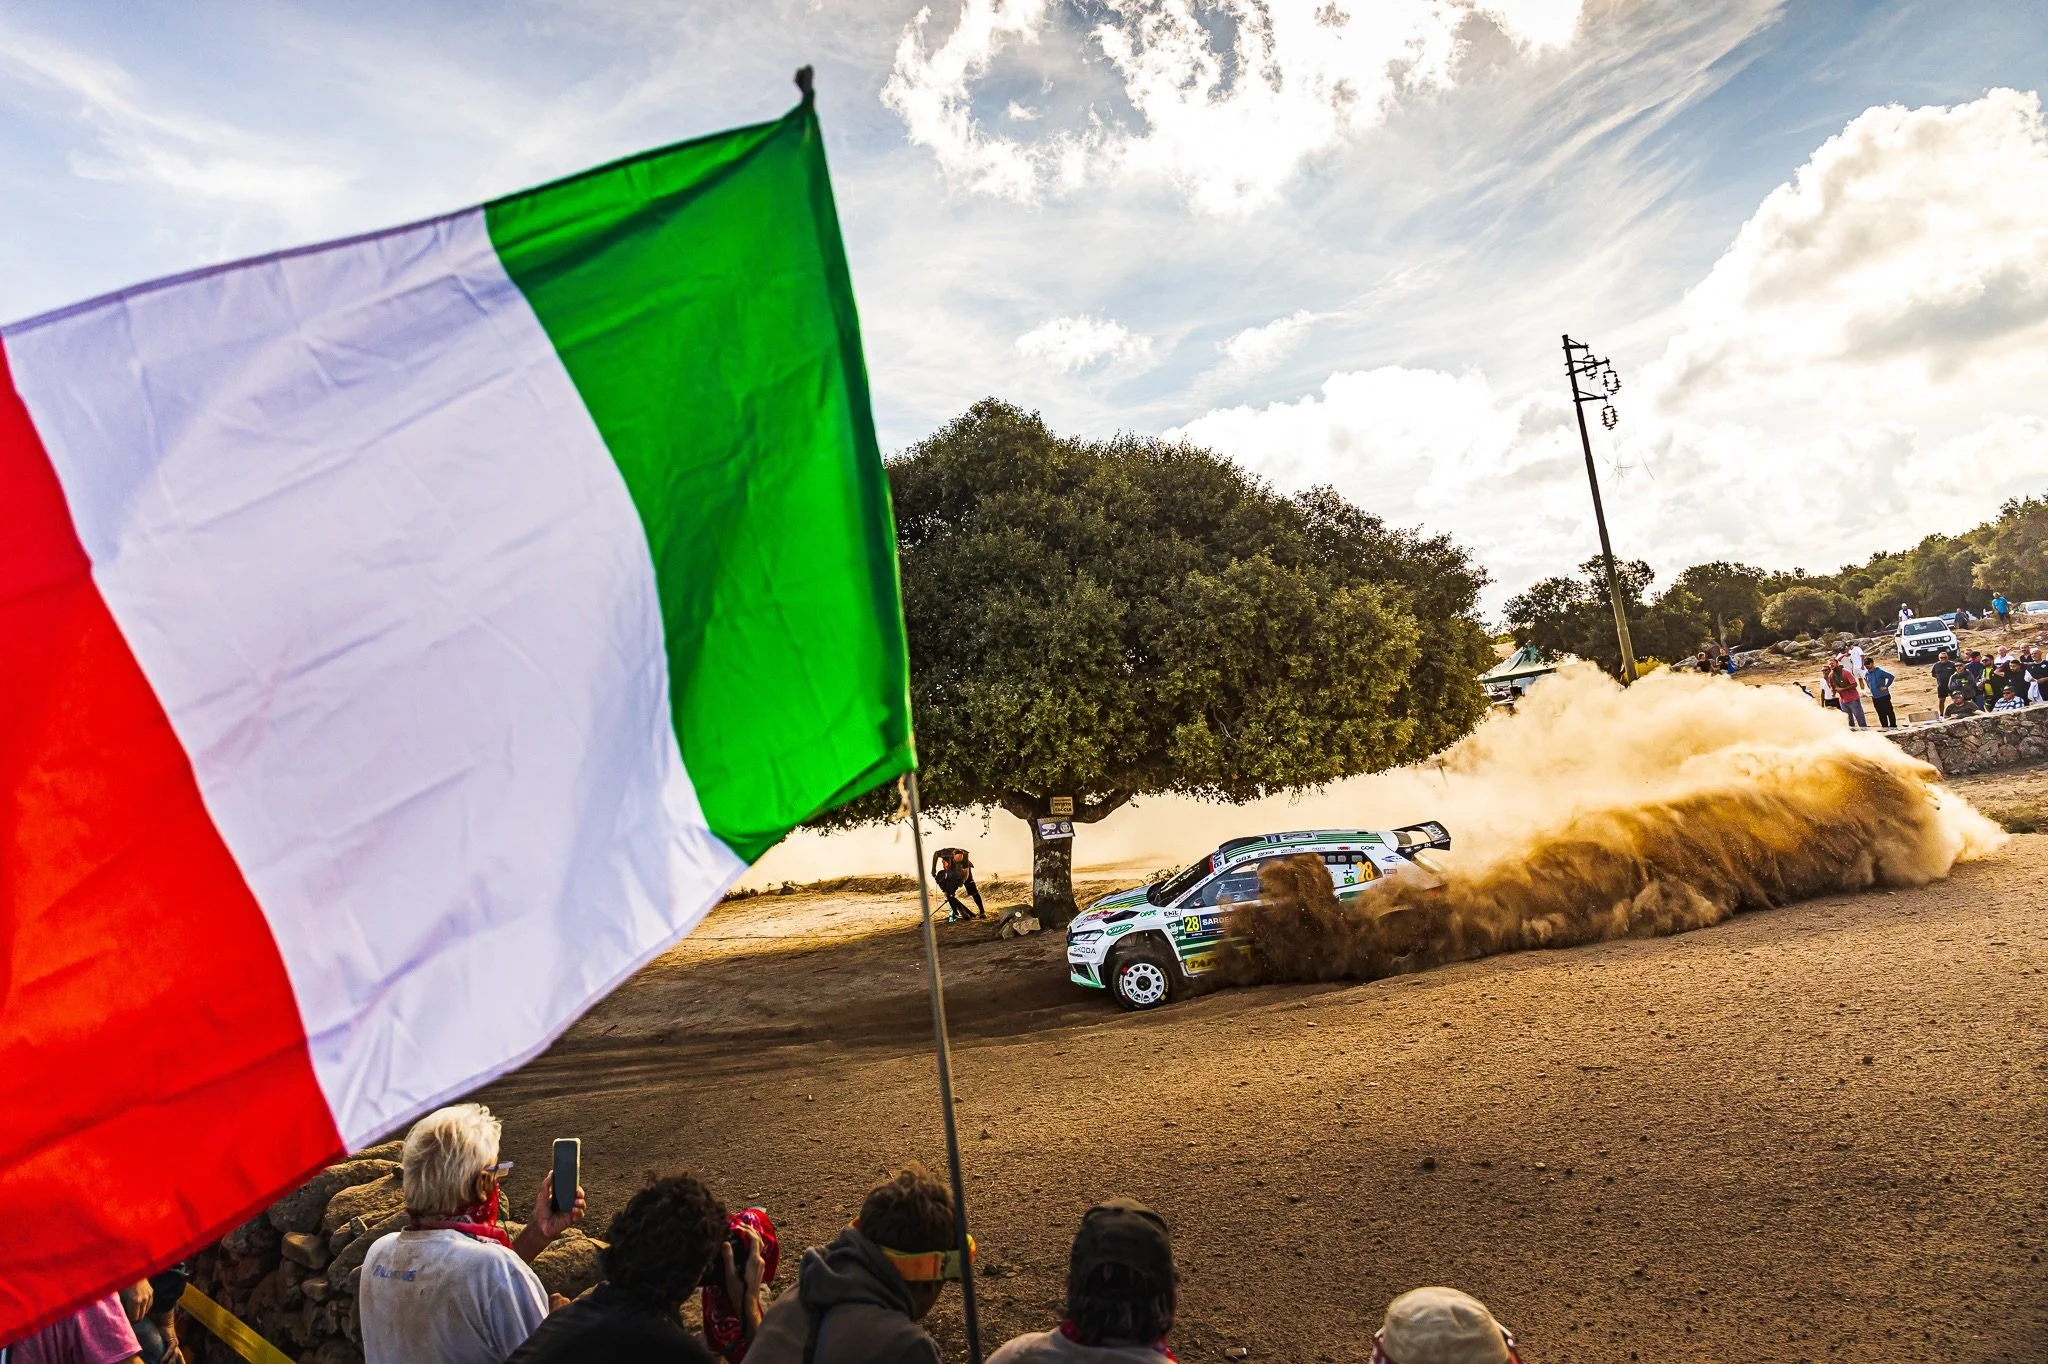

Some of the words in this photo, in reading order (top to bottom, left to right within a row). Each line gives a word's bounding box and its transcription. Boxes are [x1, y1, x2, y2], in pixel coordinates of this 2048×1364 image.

[1235, 854, 1252, 863] GRX
[1355, 861, 1374, 883] 28
[1185, 916, 1200, 932] 28
